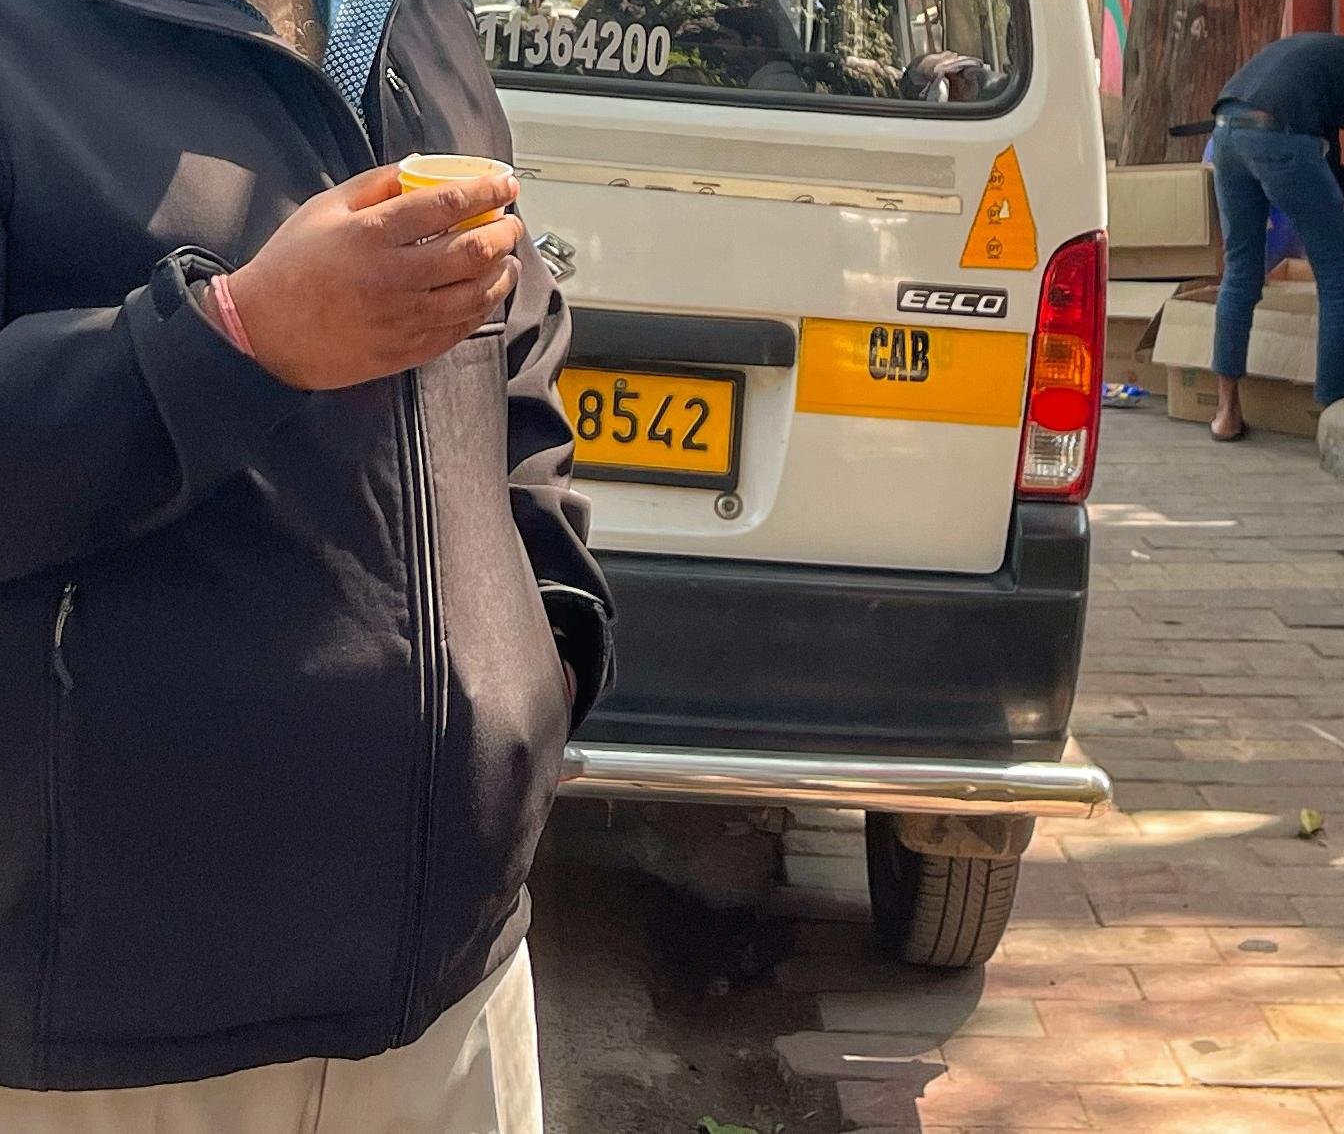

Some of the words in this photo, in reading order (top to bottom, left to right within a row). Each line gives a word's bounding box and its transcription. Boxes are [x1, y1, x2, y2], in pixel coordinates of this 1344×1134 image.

[900, 289, 1006, 314] EECO
[869, 326, 930, 382] CAB
[577, 388, 710, 451] 8542
